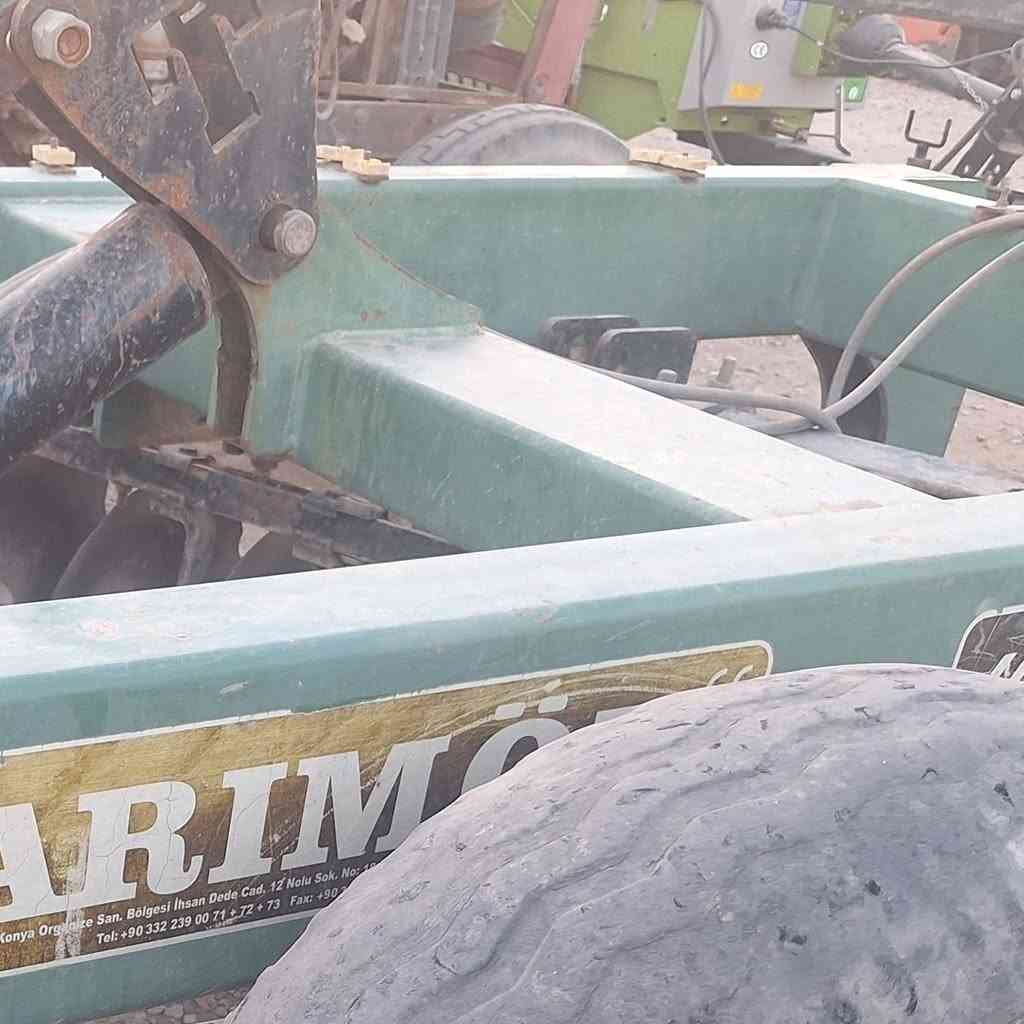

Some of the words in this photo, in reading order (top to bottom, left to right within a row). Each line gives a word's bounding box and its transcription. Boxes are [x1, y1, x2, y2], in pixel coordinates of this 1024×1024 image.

[39, 918, 94, 938] Orgze
[97, 912, 123, 926] San.
[127, 902, 171, 921] Bölgesi
[174, 896, 206, 914] İhsan
[208, 889, 238, 904] Dede
[240, 883, 267, 898] Cad.
[270, 879, 284, 892] 12
[286, 875, 312, 889] Nolu
[314, 869, 338, 883] Sok.
[341, 866, 360, 878] No:
[97, 931, 119, 945] Tel:
[121, 925, 144, 940] +90
[145, 920, 167, 935] 332
[170, 915, 192, 930] 239
[194, 911, 209, 925] 00
[212, 909, 226, 921] 71
[239, 903, 254, 917] 72
[267, 899, 281, 911] 73
[290, 895, 313, 907] Fax:
[316, 887, 338, 900] +90
